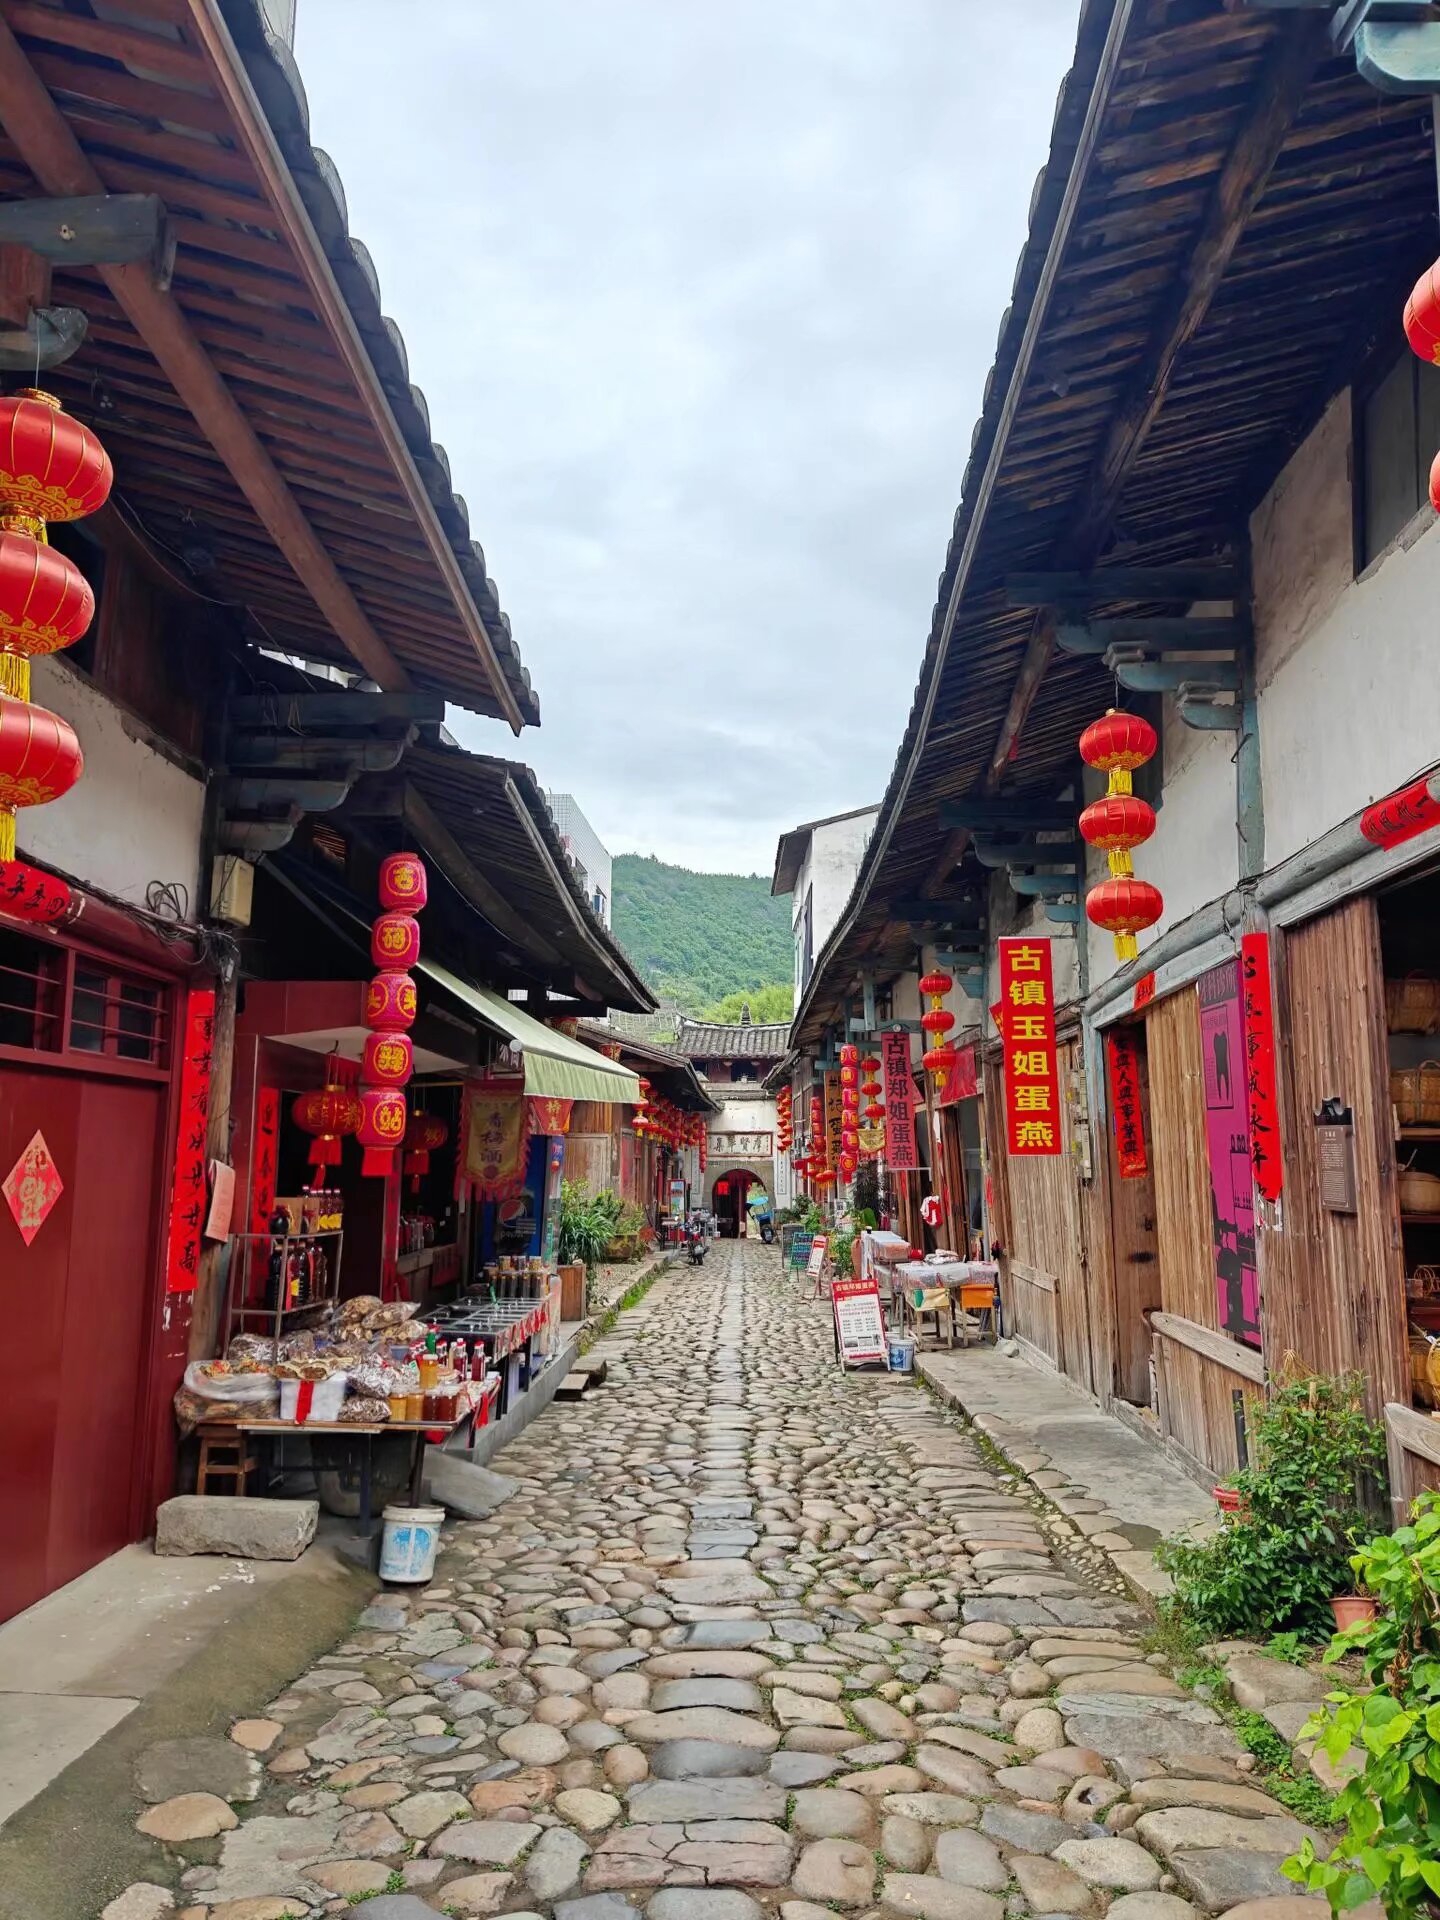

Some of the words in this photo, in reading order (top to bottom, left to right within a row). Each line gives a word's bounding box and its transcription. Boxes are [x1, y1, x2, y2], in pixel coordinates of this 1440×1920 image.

[885, 1034, 912, 1166] 古镇郑姐蛋燕
[1007, 945, 1054, 1148] 古镇玉姐蛋燕
